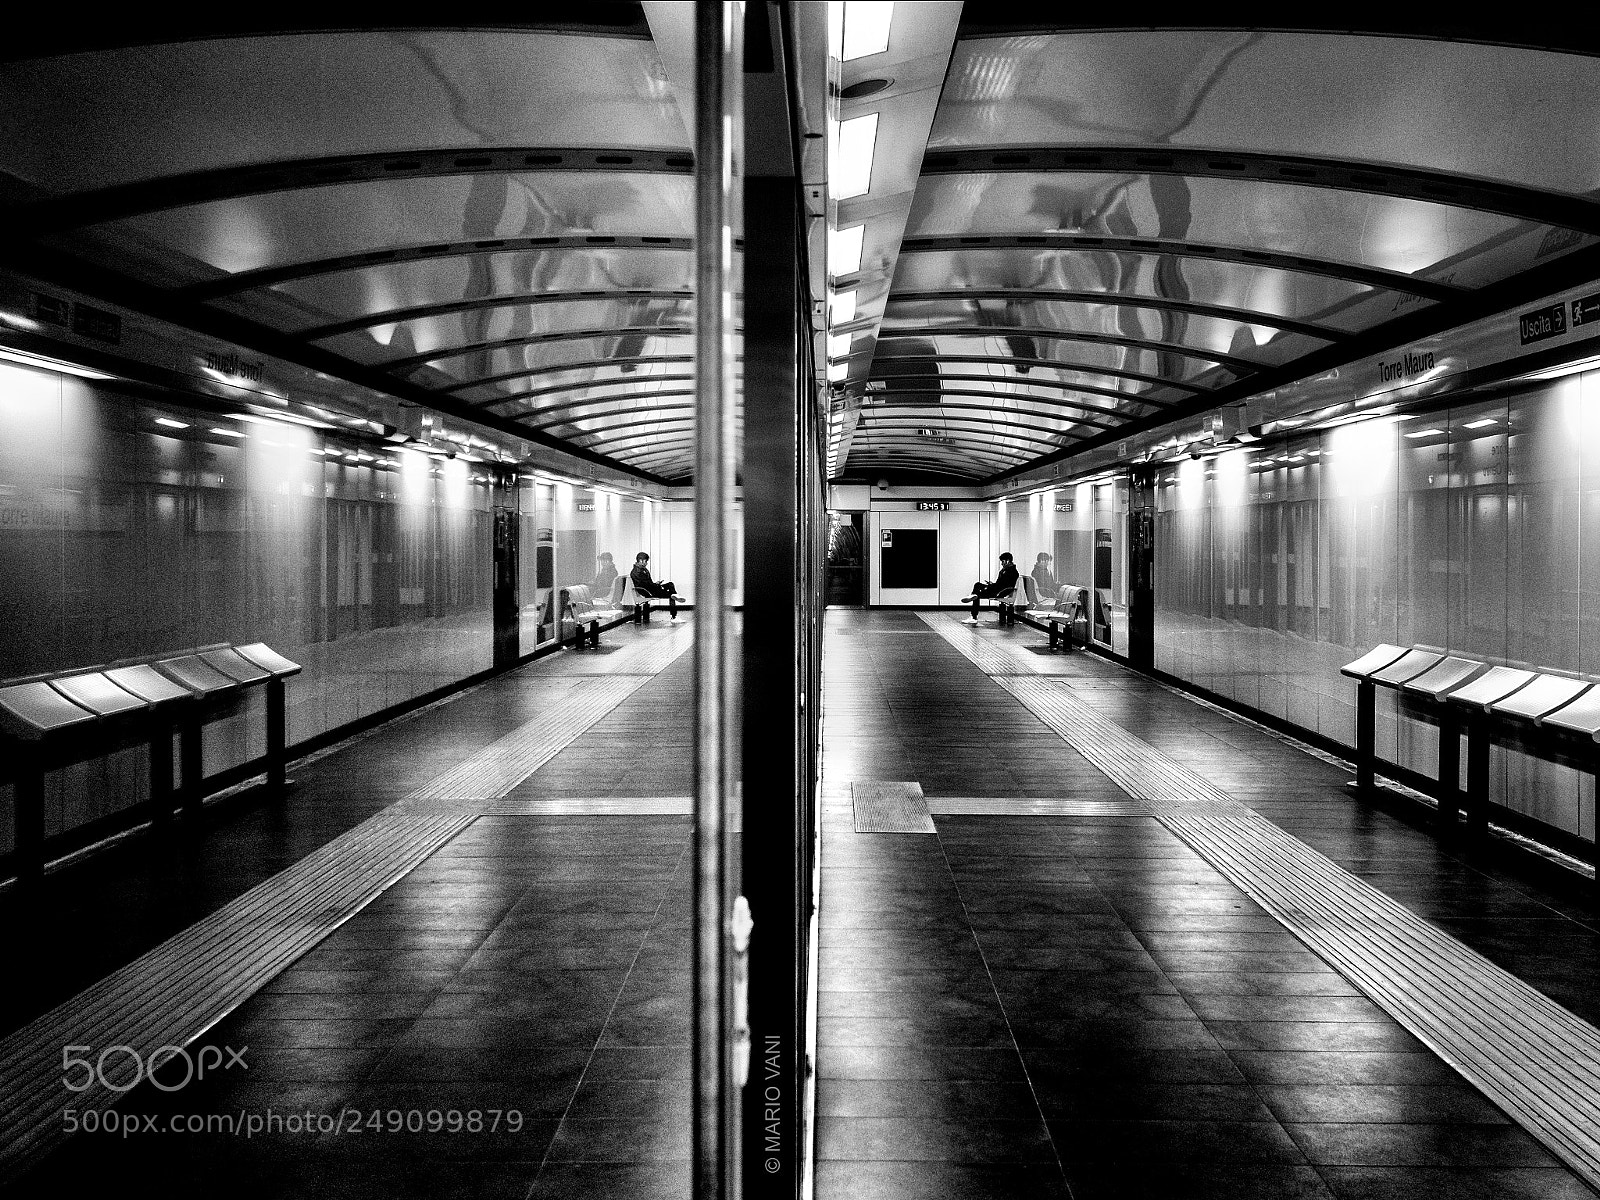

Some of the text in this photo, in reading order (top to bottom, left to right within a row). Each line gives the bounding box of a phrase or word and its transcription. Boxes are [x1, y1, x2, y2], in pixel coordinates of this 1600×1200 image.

[1521, 316, 1552, 339] Uscita
[1378, 352, 1435, 383] Torre Maura
